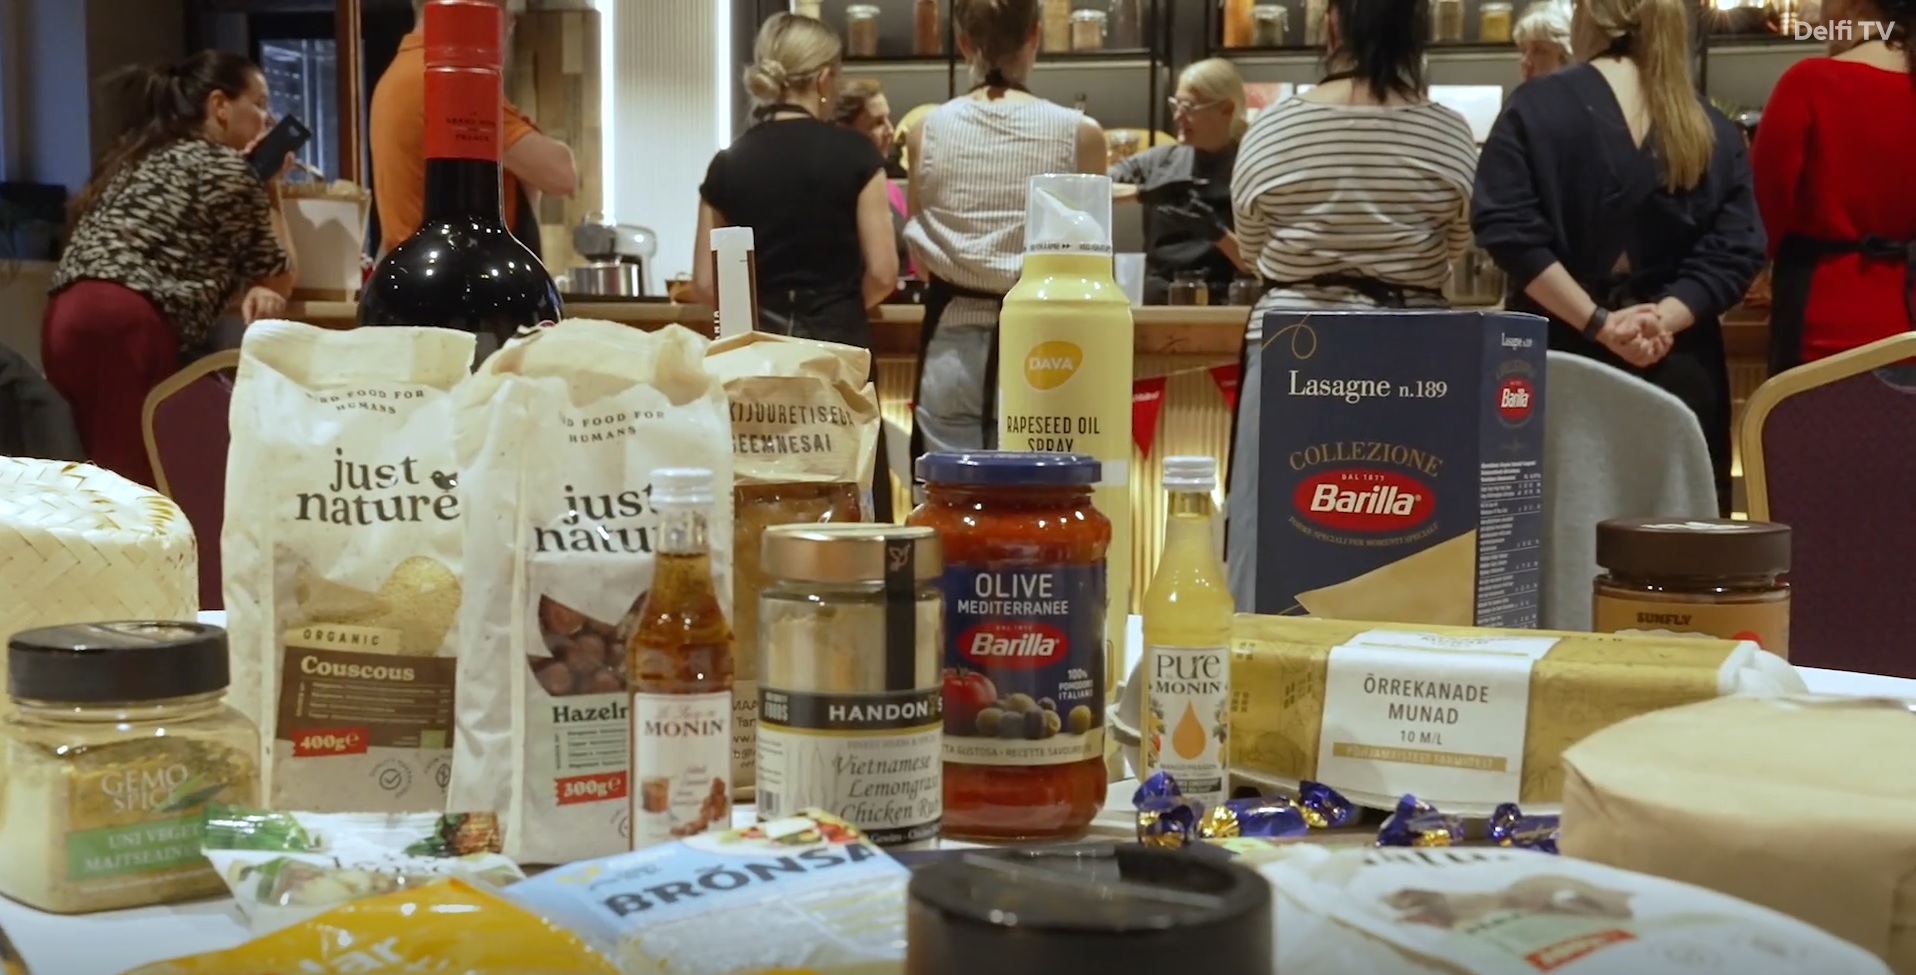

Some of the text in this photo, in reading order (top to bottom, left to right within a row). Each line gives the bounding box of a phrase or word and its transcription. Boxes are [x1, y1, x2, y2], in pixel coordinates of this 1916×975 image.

[1029, 356, 1074, 371] DAVA
[346, 389, 387, 400] FOOD
[394, 389, 424, 400] FOR
[1288, 369, 1448, 404] Lasagne n.189
[335, 402, 397, 415] HUMANS
[582, 413, 627, 428] FOOD
[633, 410, 665, 420] FOR
[568, 425, 636, 444] HUMANS
[1006, 415, 1101, 435] RAPESEED OIL
[1027, 438, 1075, 452] SPRAY
[328, 446, 420, 493] just
[1289, 440, 1444, 479] COLLEZIONE
[1341, 473, 1360, 481] DAL
[294, 491, 462, 526] nature
[1310, 483, 1416, 516] Barilla
[534, 524, 658, 554] natu
[974, 572, 1054, 599] OLIVE
[1636, 612, 1693, 626] SUNFLY
[303, 629, 380, 646] ORGANIC
[969, 632, 1057, 657] Barilla
[300, 655, 416, 682] Couscous
[1066, 668, 1088, 680] 100%
[1058, 689, 1093, 701] ITALIANI
[1155, 681, 1221, 694] MONIN
[1363, 672, 1490, 703] ÕRREKANADE
[828, 697, 944, 722] HANDONS
[1387, 702, 1460, 725] MUNAD
[644, 719, 724, 737] MONIN
[1400, 729, 1443, 746] 10 M/L
[957, 744, 999, 757] GUSTOSA
[832, 754, 932, 776] Vietnamese
[101, 763, 188, 796] GEMO
[113, 786, 178, 813] SPIC
[840, 800, 913, 824] Chicken
[108, 822, 200, 849] UNI VEGET
[602, 843, 878, 919] BRÕNSA
